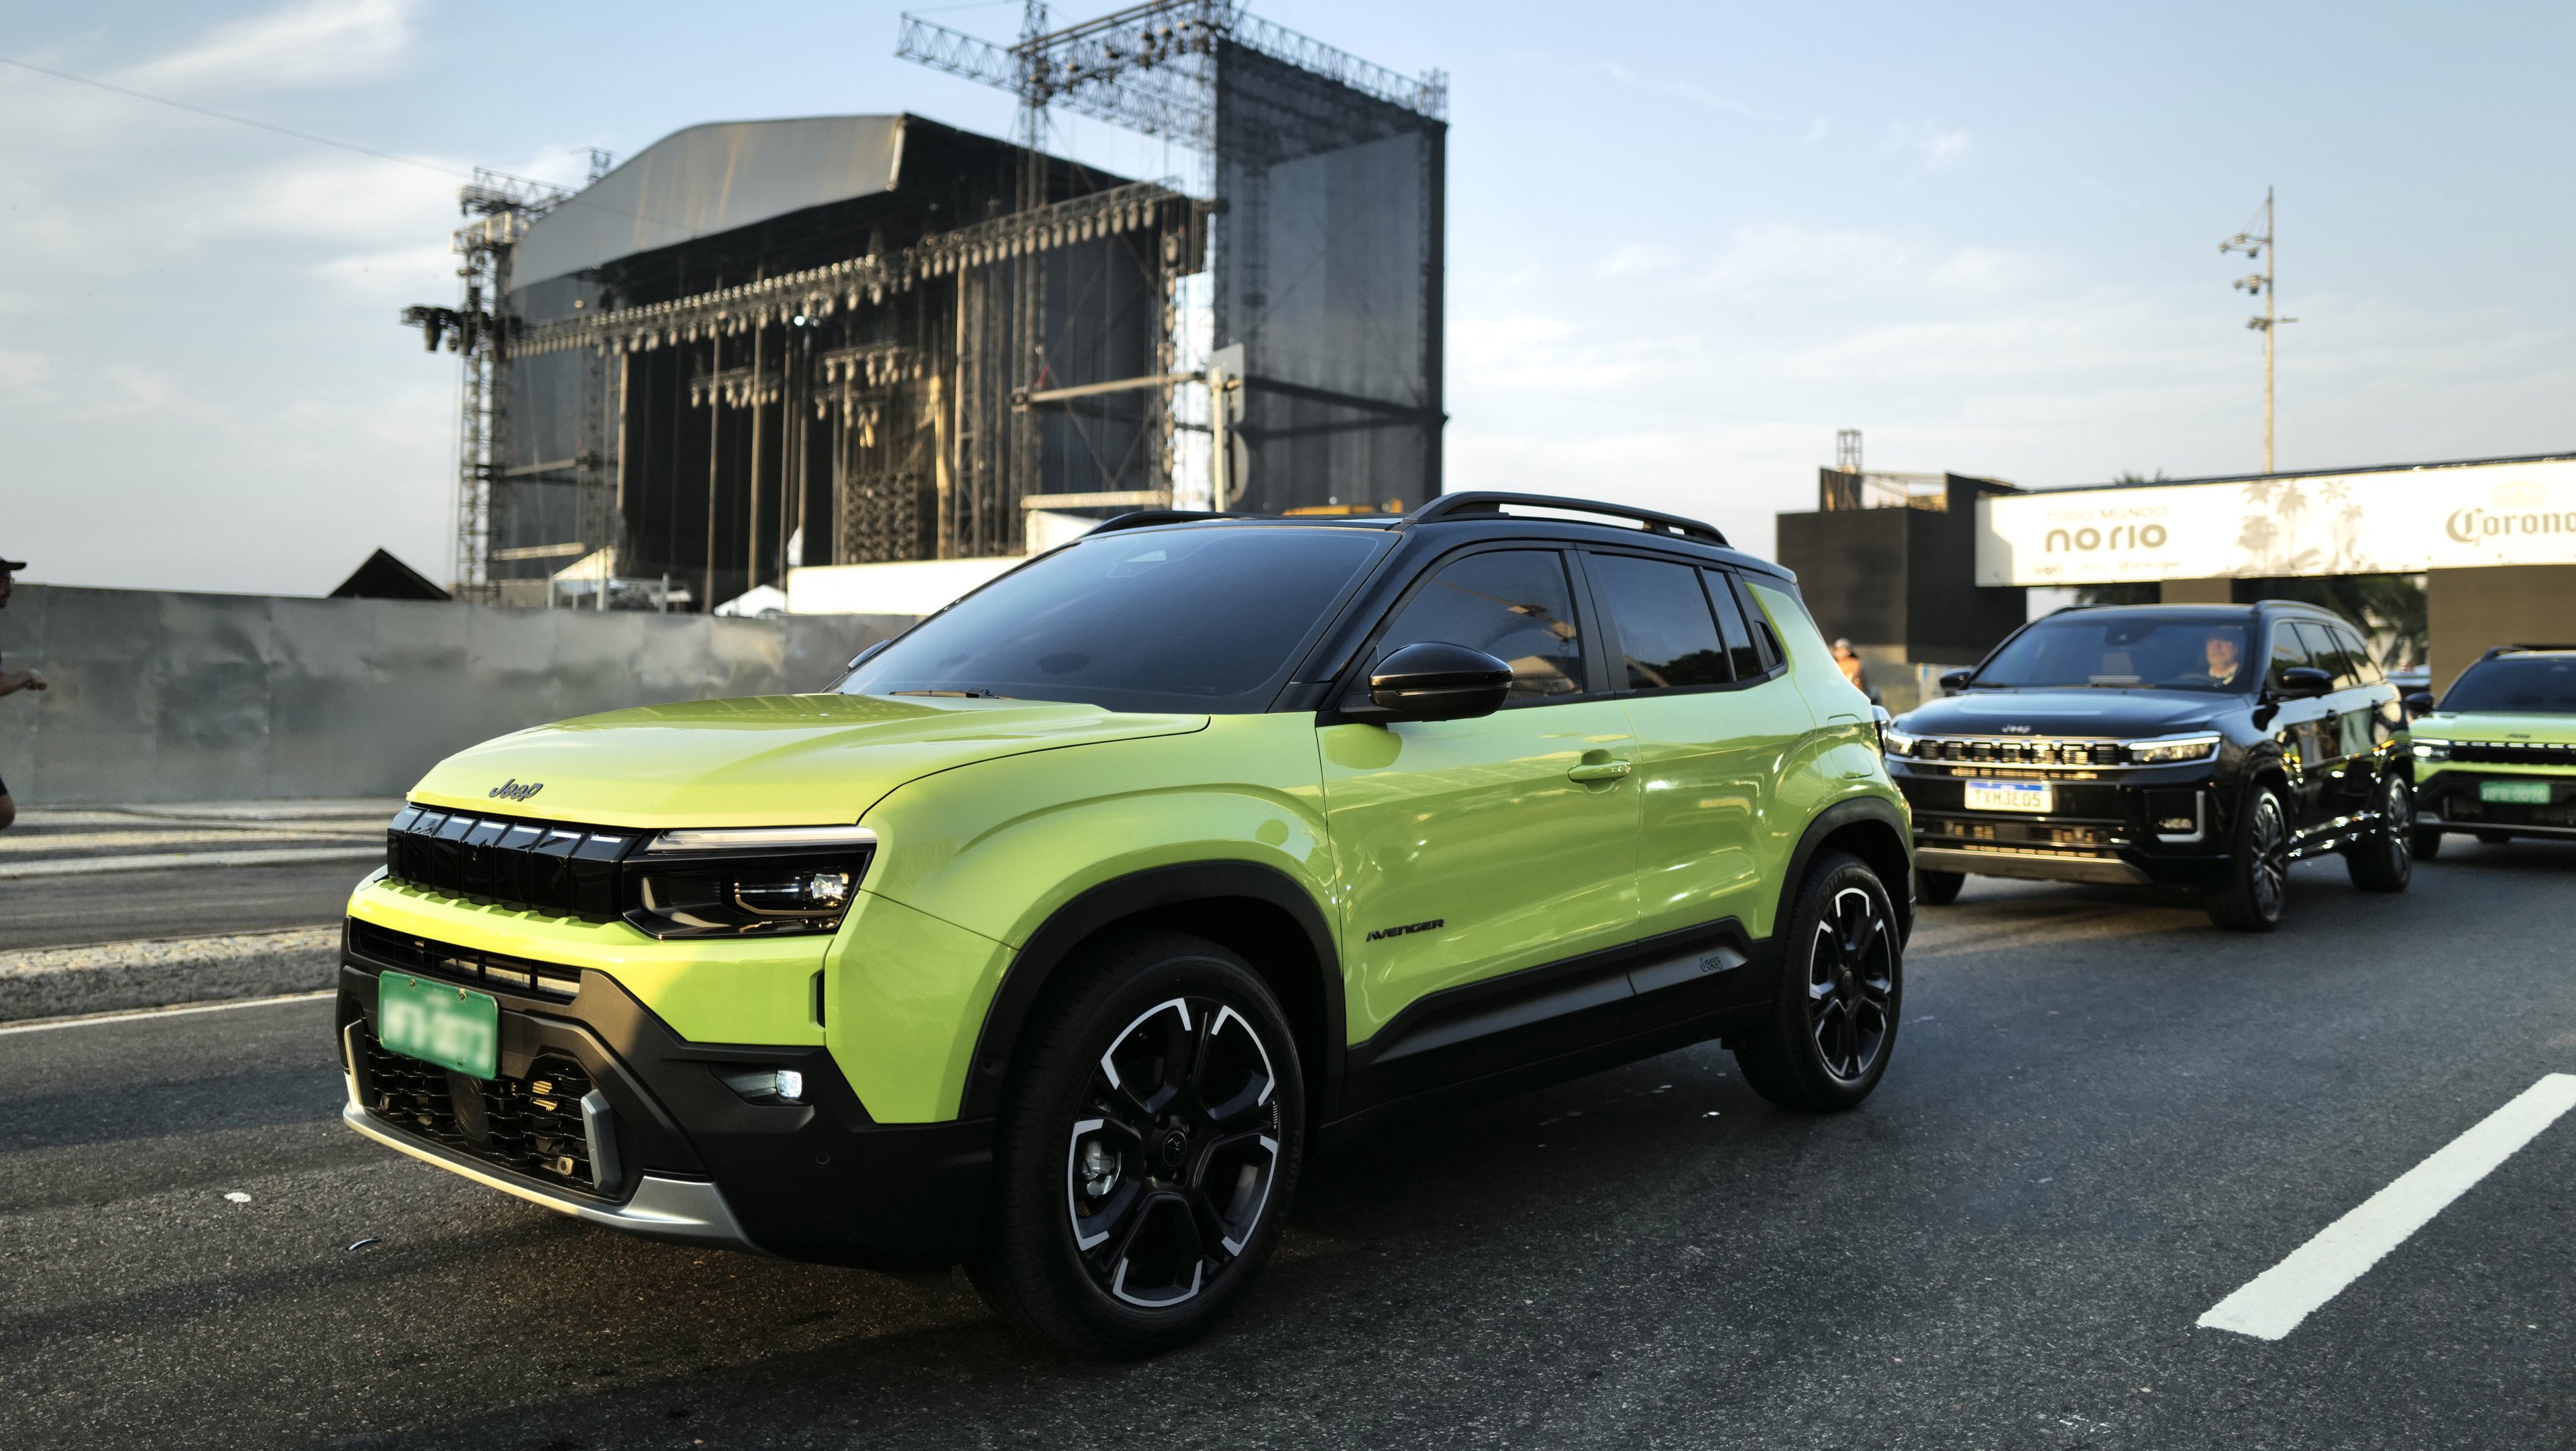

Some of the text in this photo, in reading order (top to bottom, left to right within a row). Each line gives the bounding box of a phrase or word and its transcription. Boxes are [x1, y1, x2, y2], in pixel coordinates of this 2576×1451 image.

[488, 778, 543, 802] Jeep
[1366, 918, 1444, 942] AVENGER
[1700, 956, 1723, 972] Jeep
